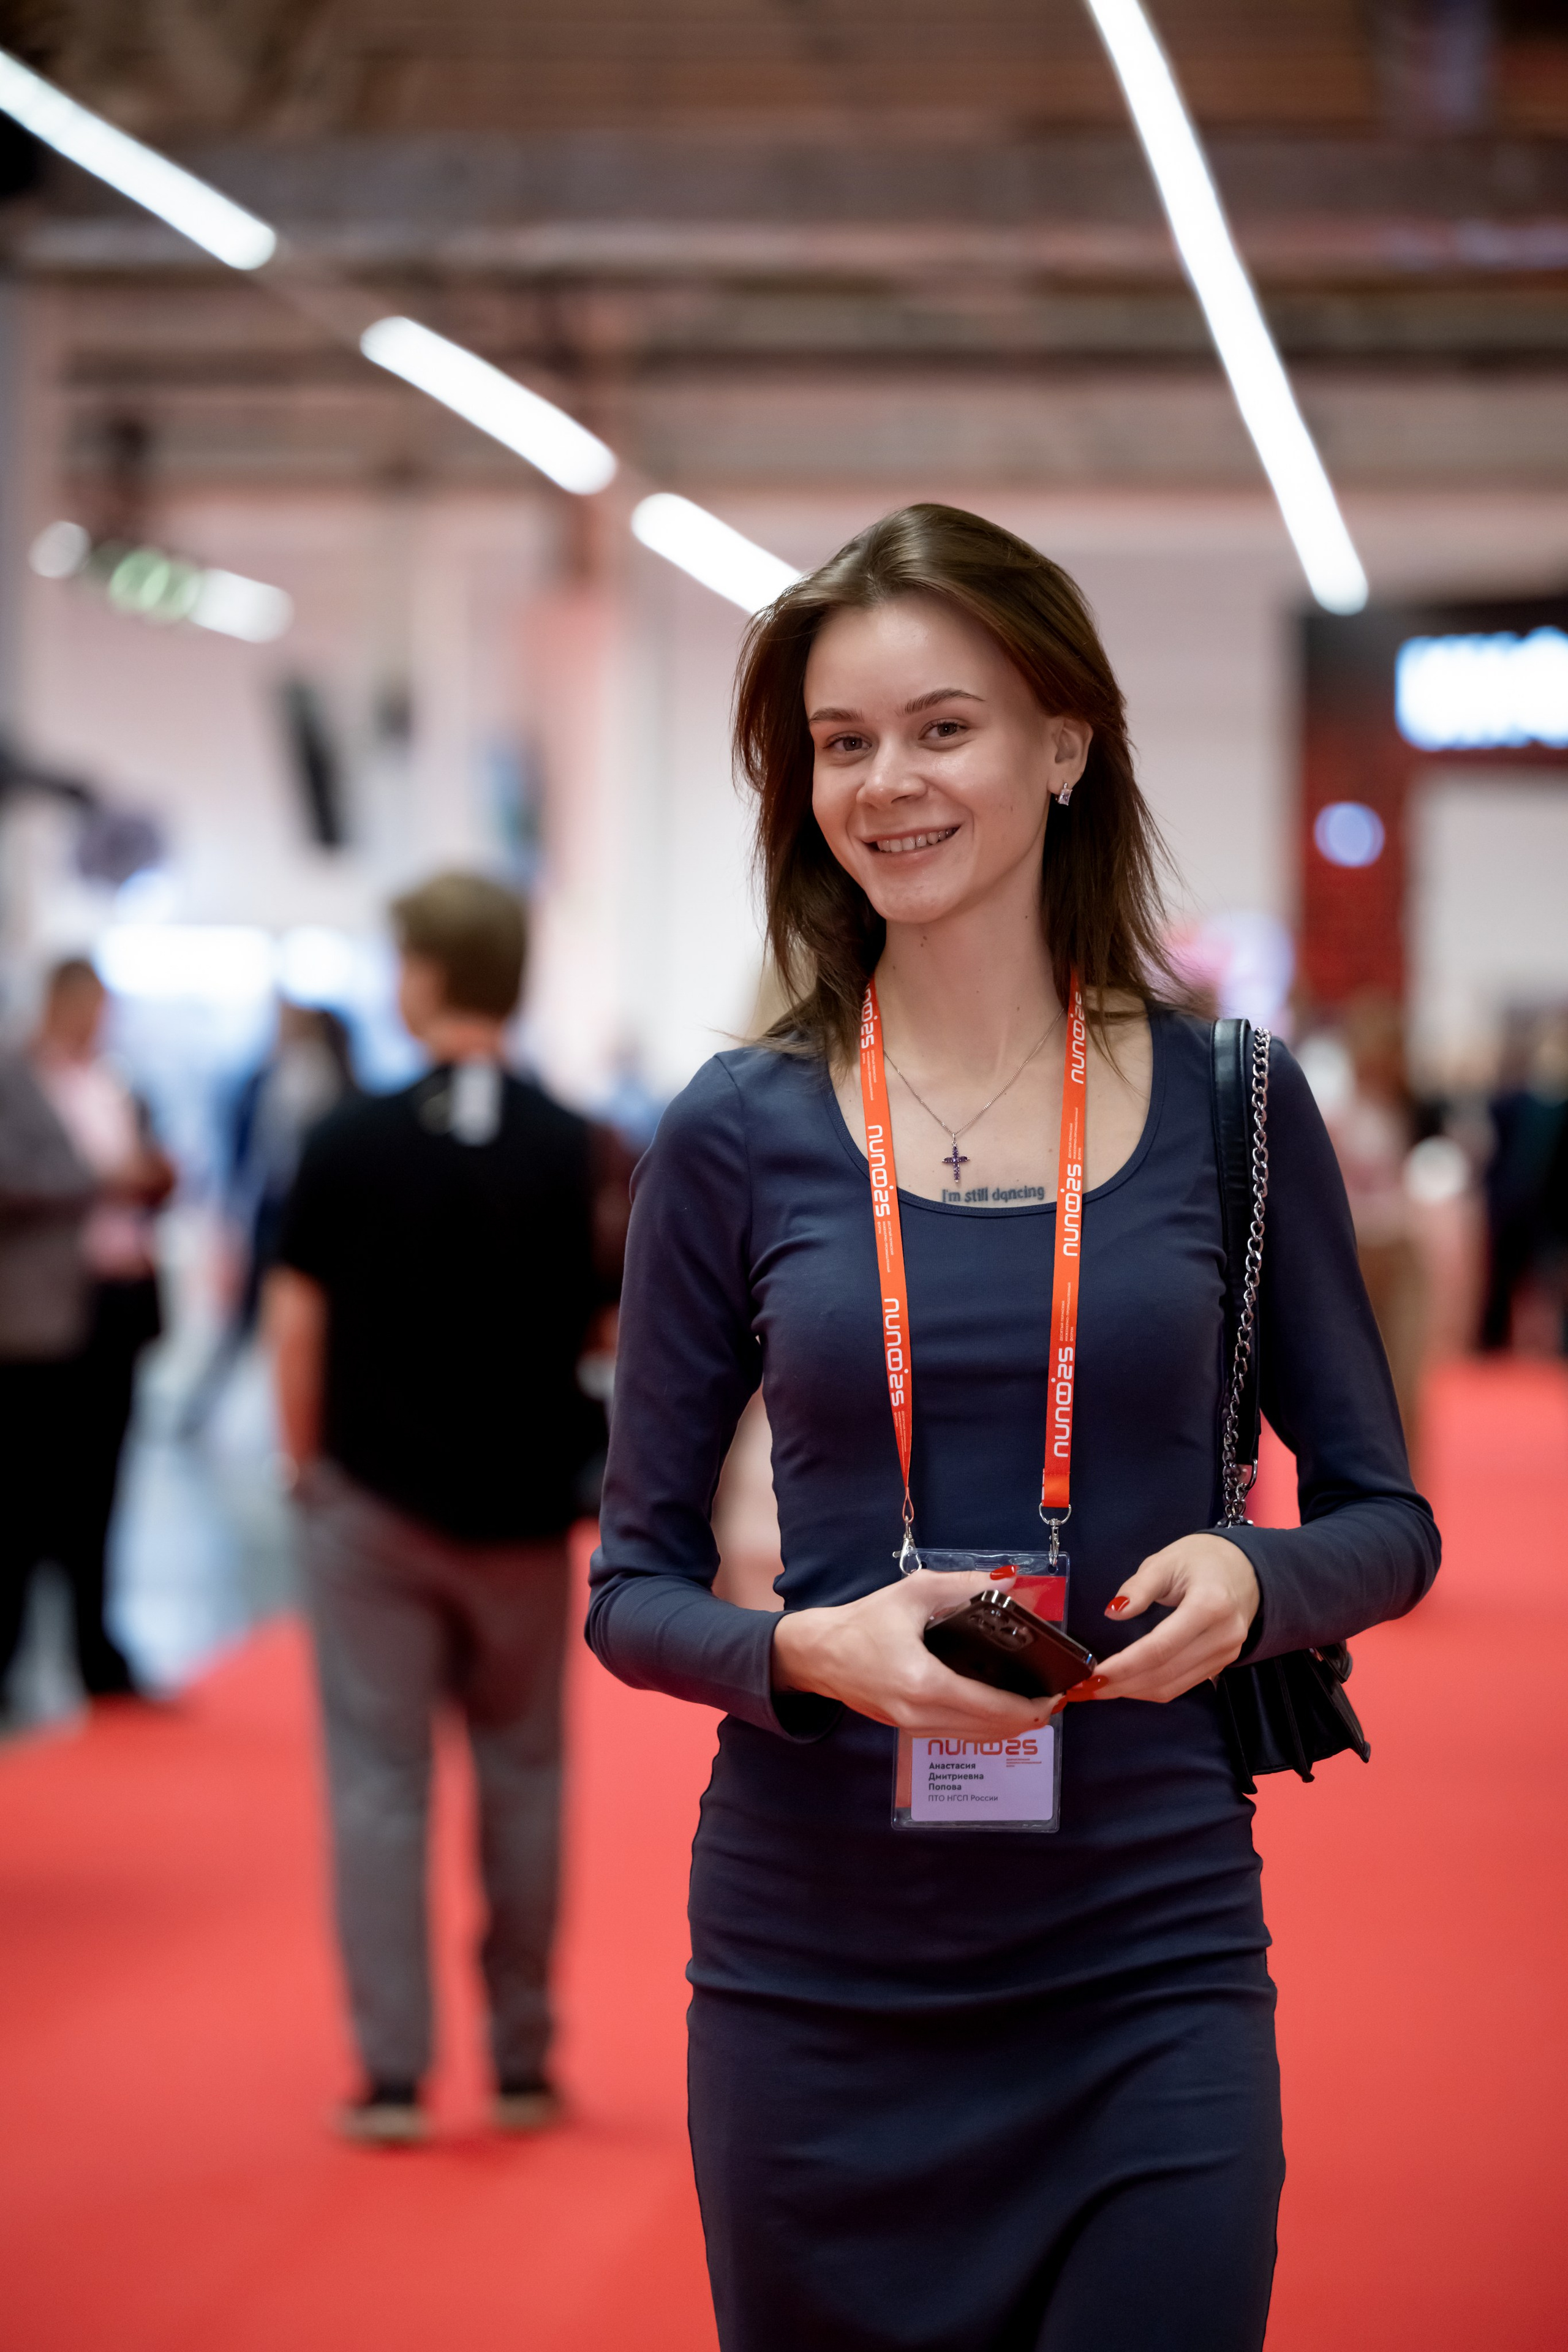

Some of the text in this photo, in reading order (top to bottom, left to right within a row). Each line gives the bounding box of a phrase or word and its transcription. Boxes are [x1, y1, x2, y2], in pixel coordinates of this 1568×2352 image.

[942, 1189, 960, 1202] I'm
[965, 1187, 988, 1202] still
[929, 1773, 984, 1781] Дмитриевна
